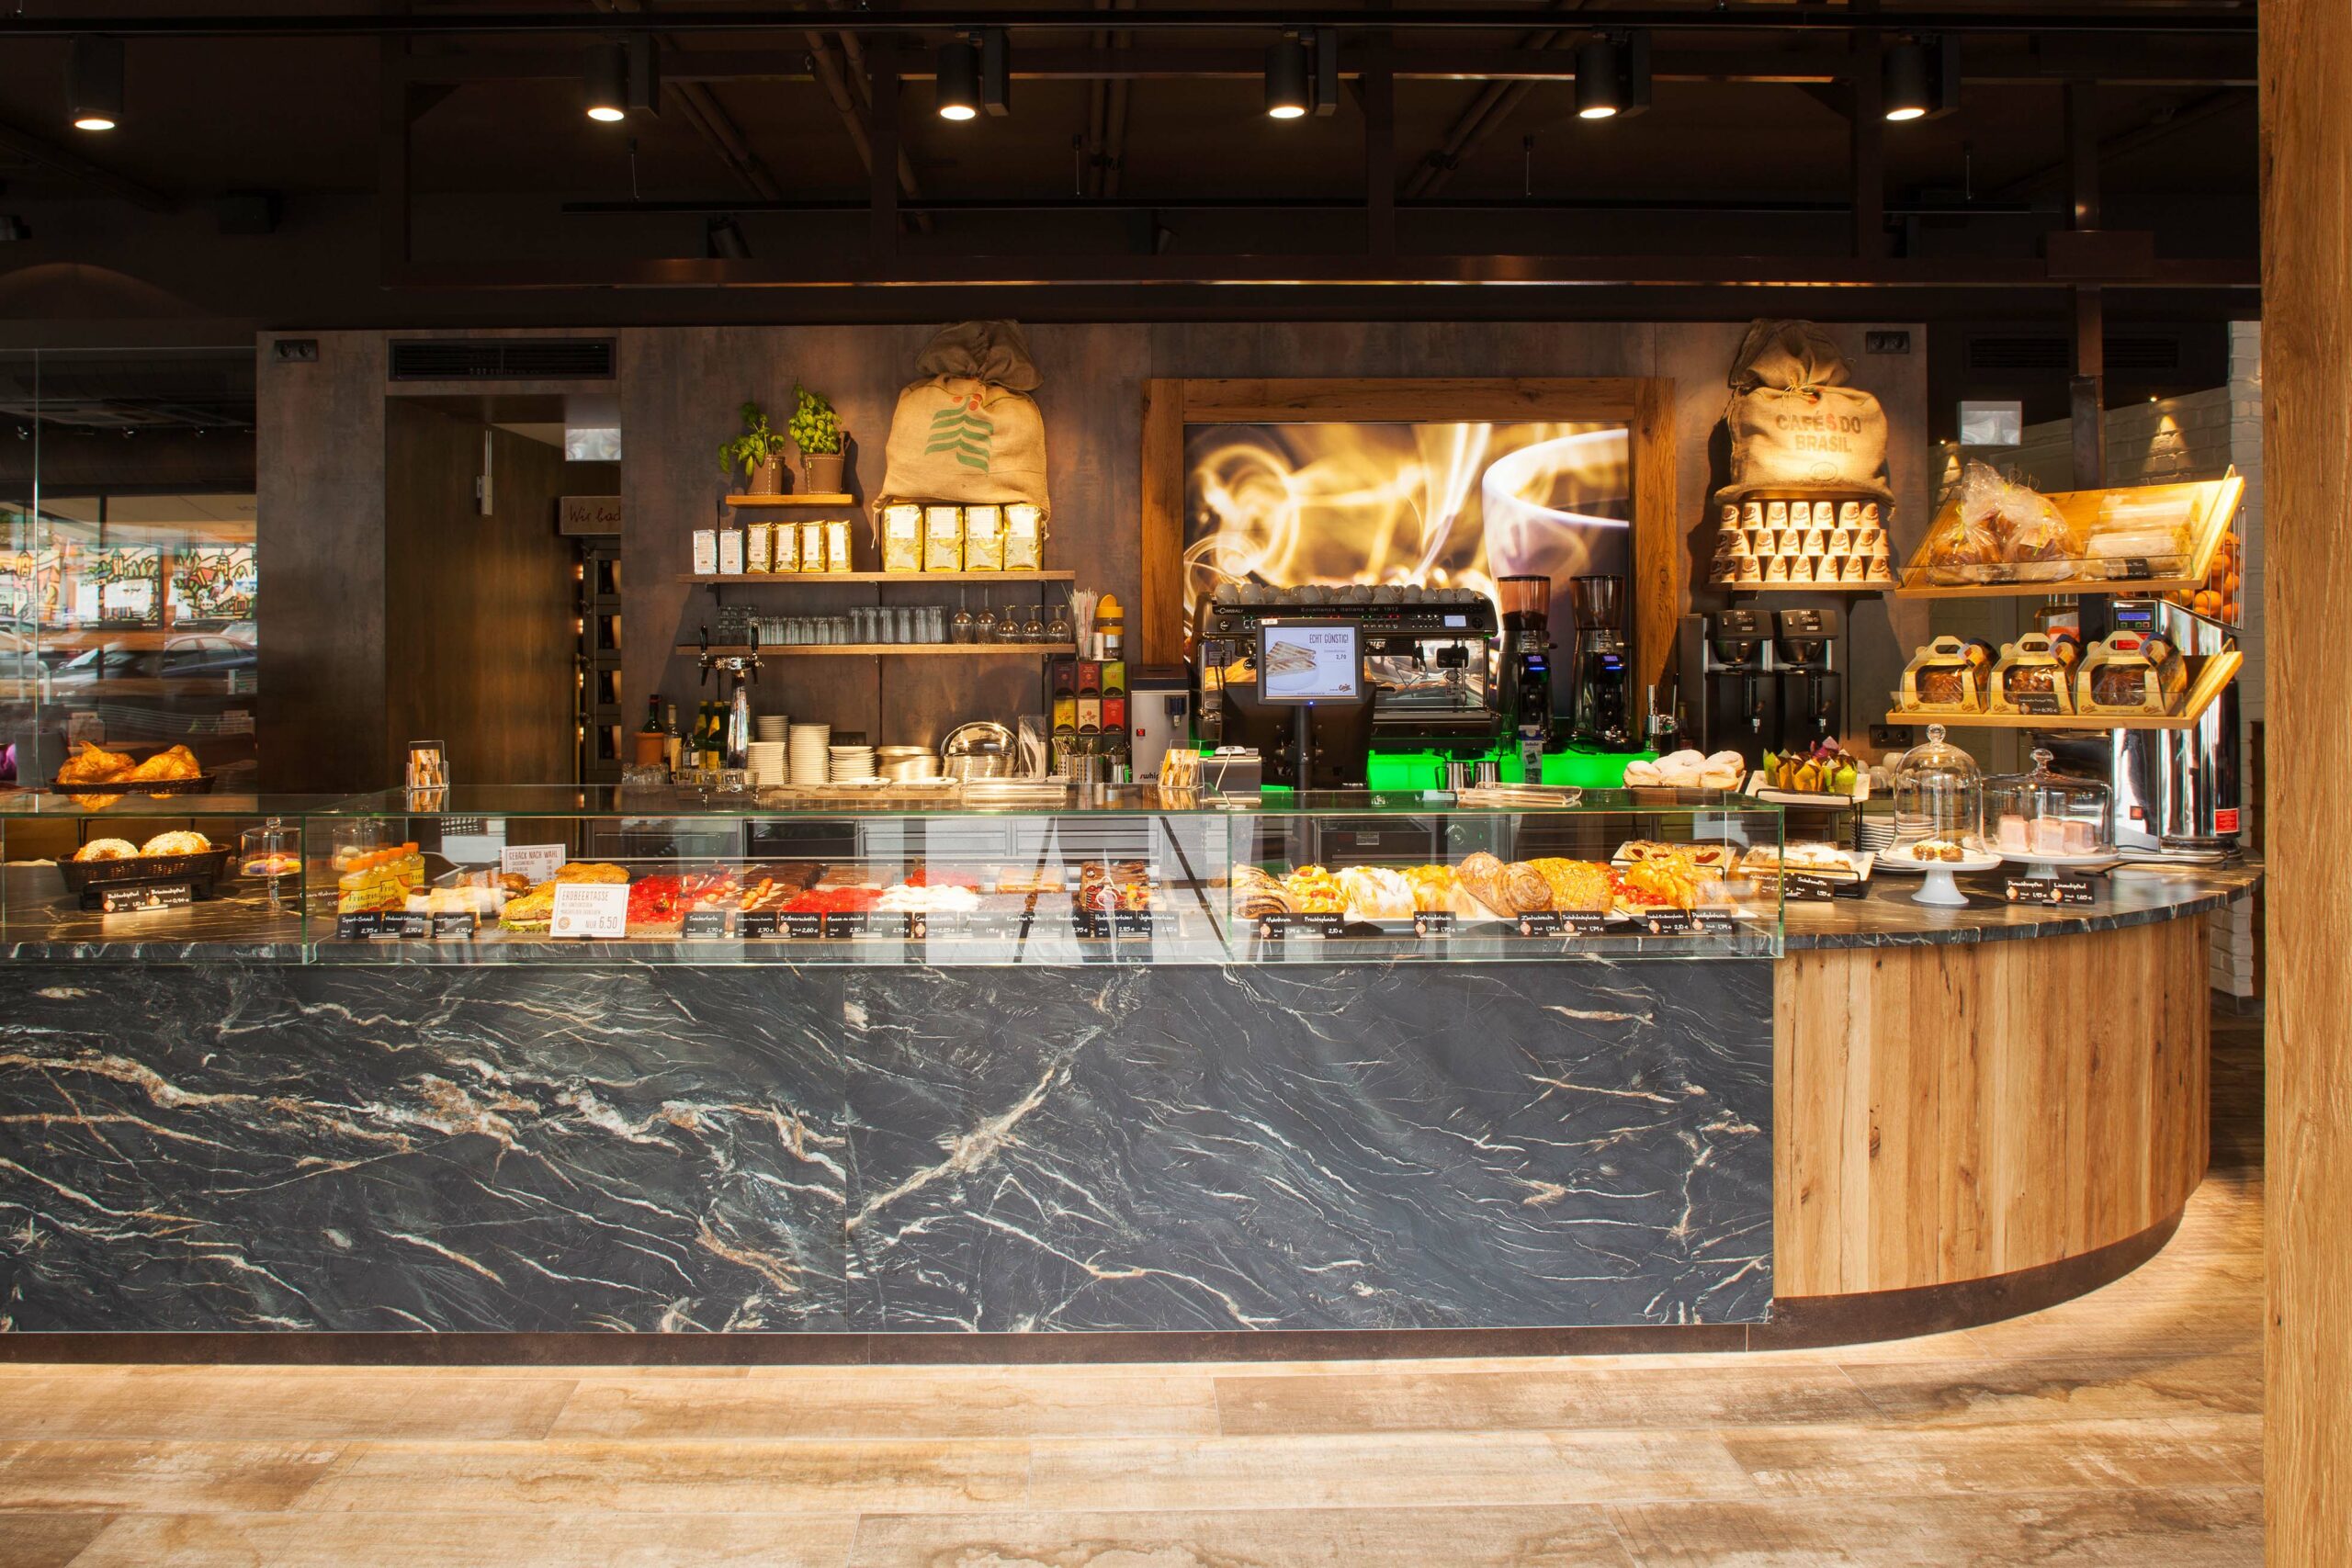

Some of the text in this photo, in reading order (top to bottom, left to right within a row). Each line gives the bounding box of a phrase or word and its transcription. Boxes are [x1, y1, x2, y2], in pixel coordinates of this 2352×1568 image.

[1776, 410, 1861, 434] CAFÉS DO
[1795, 434, 1851, 453] BRASIL
[571, 506, 591, 522] Wir
[1309, 632, 1349, 644] ECHT GÜNSTIG!
[562, 890, 609, 901] ERDBEERTASSE
